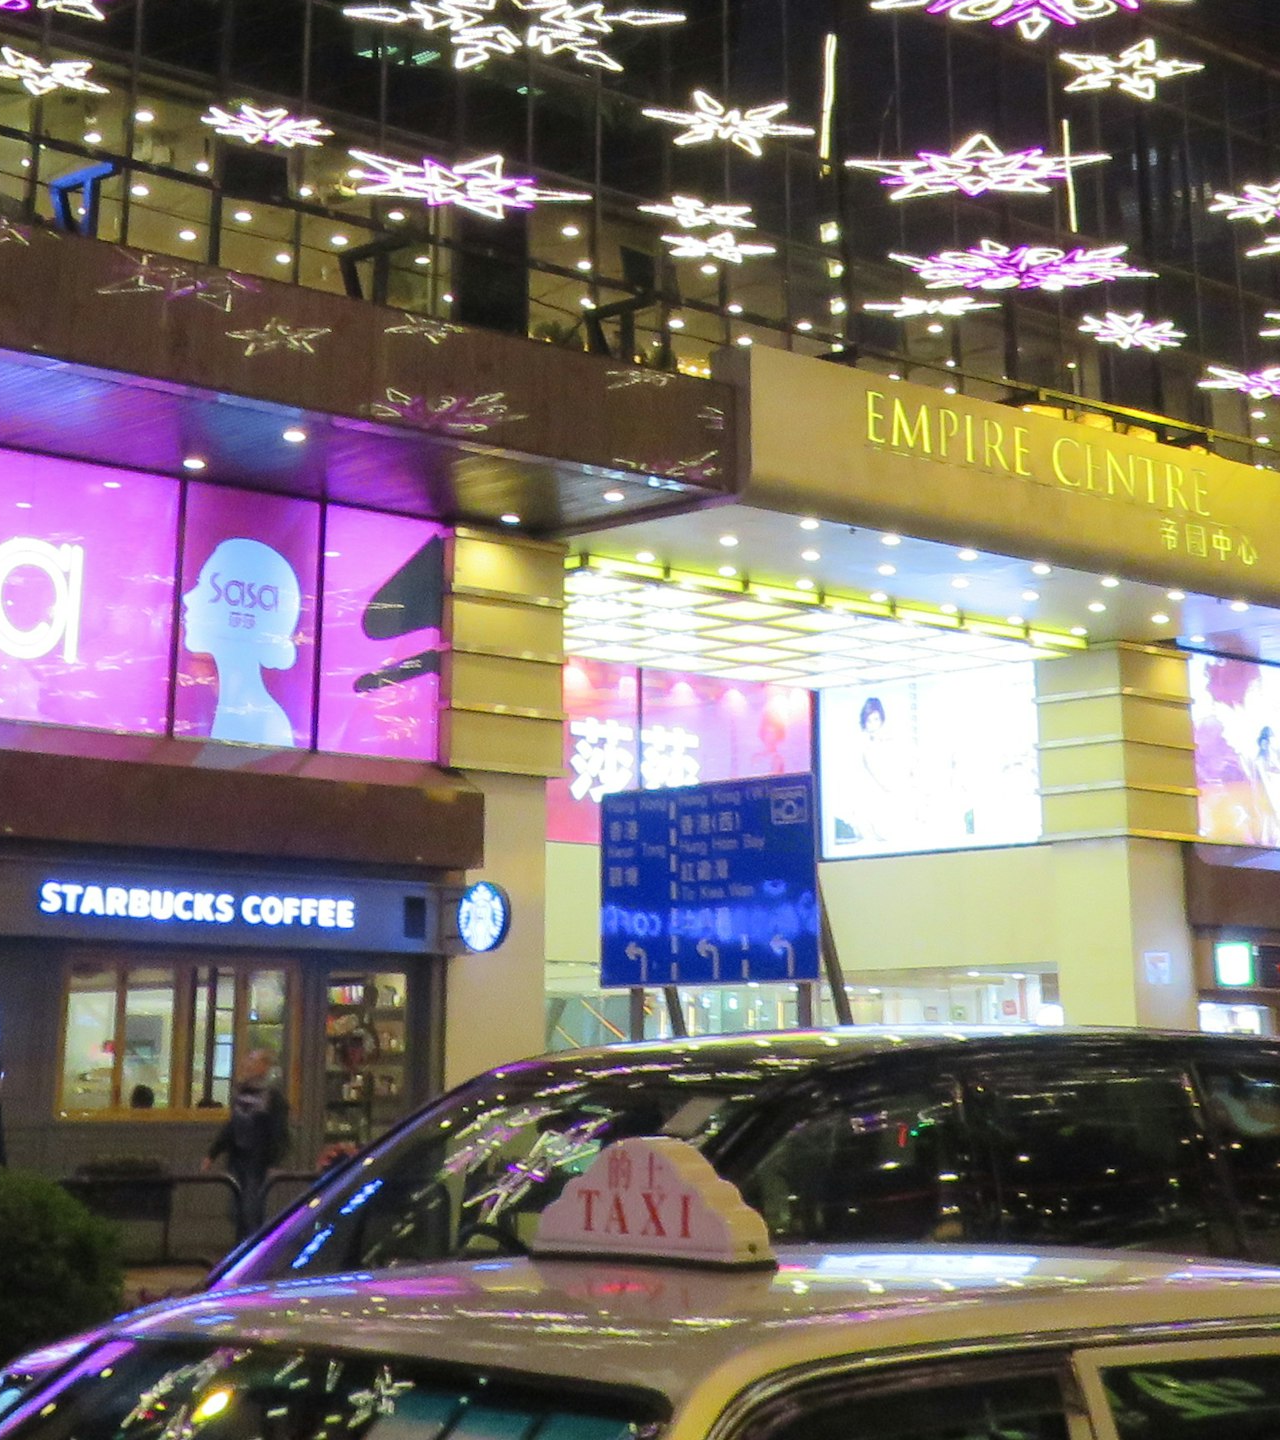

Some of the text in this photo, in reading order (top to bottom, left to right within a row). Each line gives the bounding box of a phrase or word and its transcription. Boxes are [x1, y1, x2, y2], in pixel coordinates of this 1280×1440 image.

[865, 388, 1211, 517] EMPIRE CENTRE
[40, 881, 355, 929] STARBUCKS COFFEE
[577, 1188, 696, 1240] TAXI
